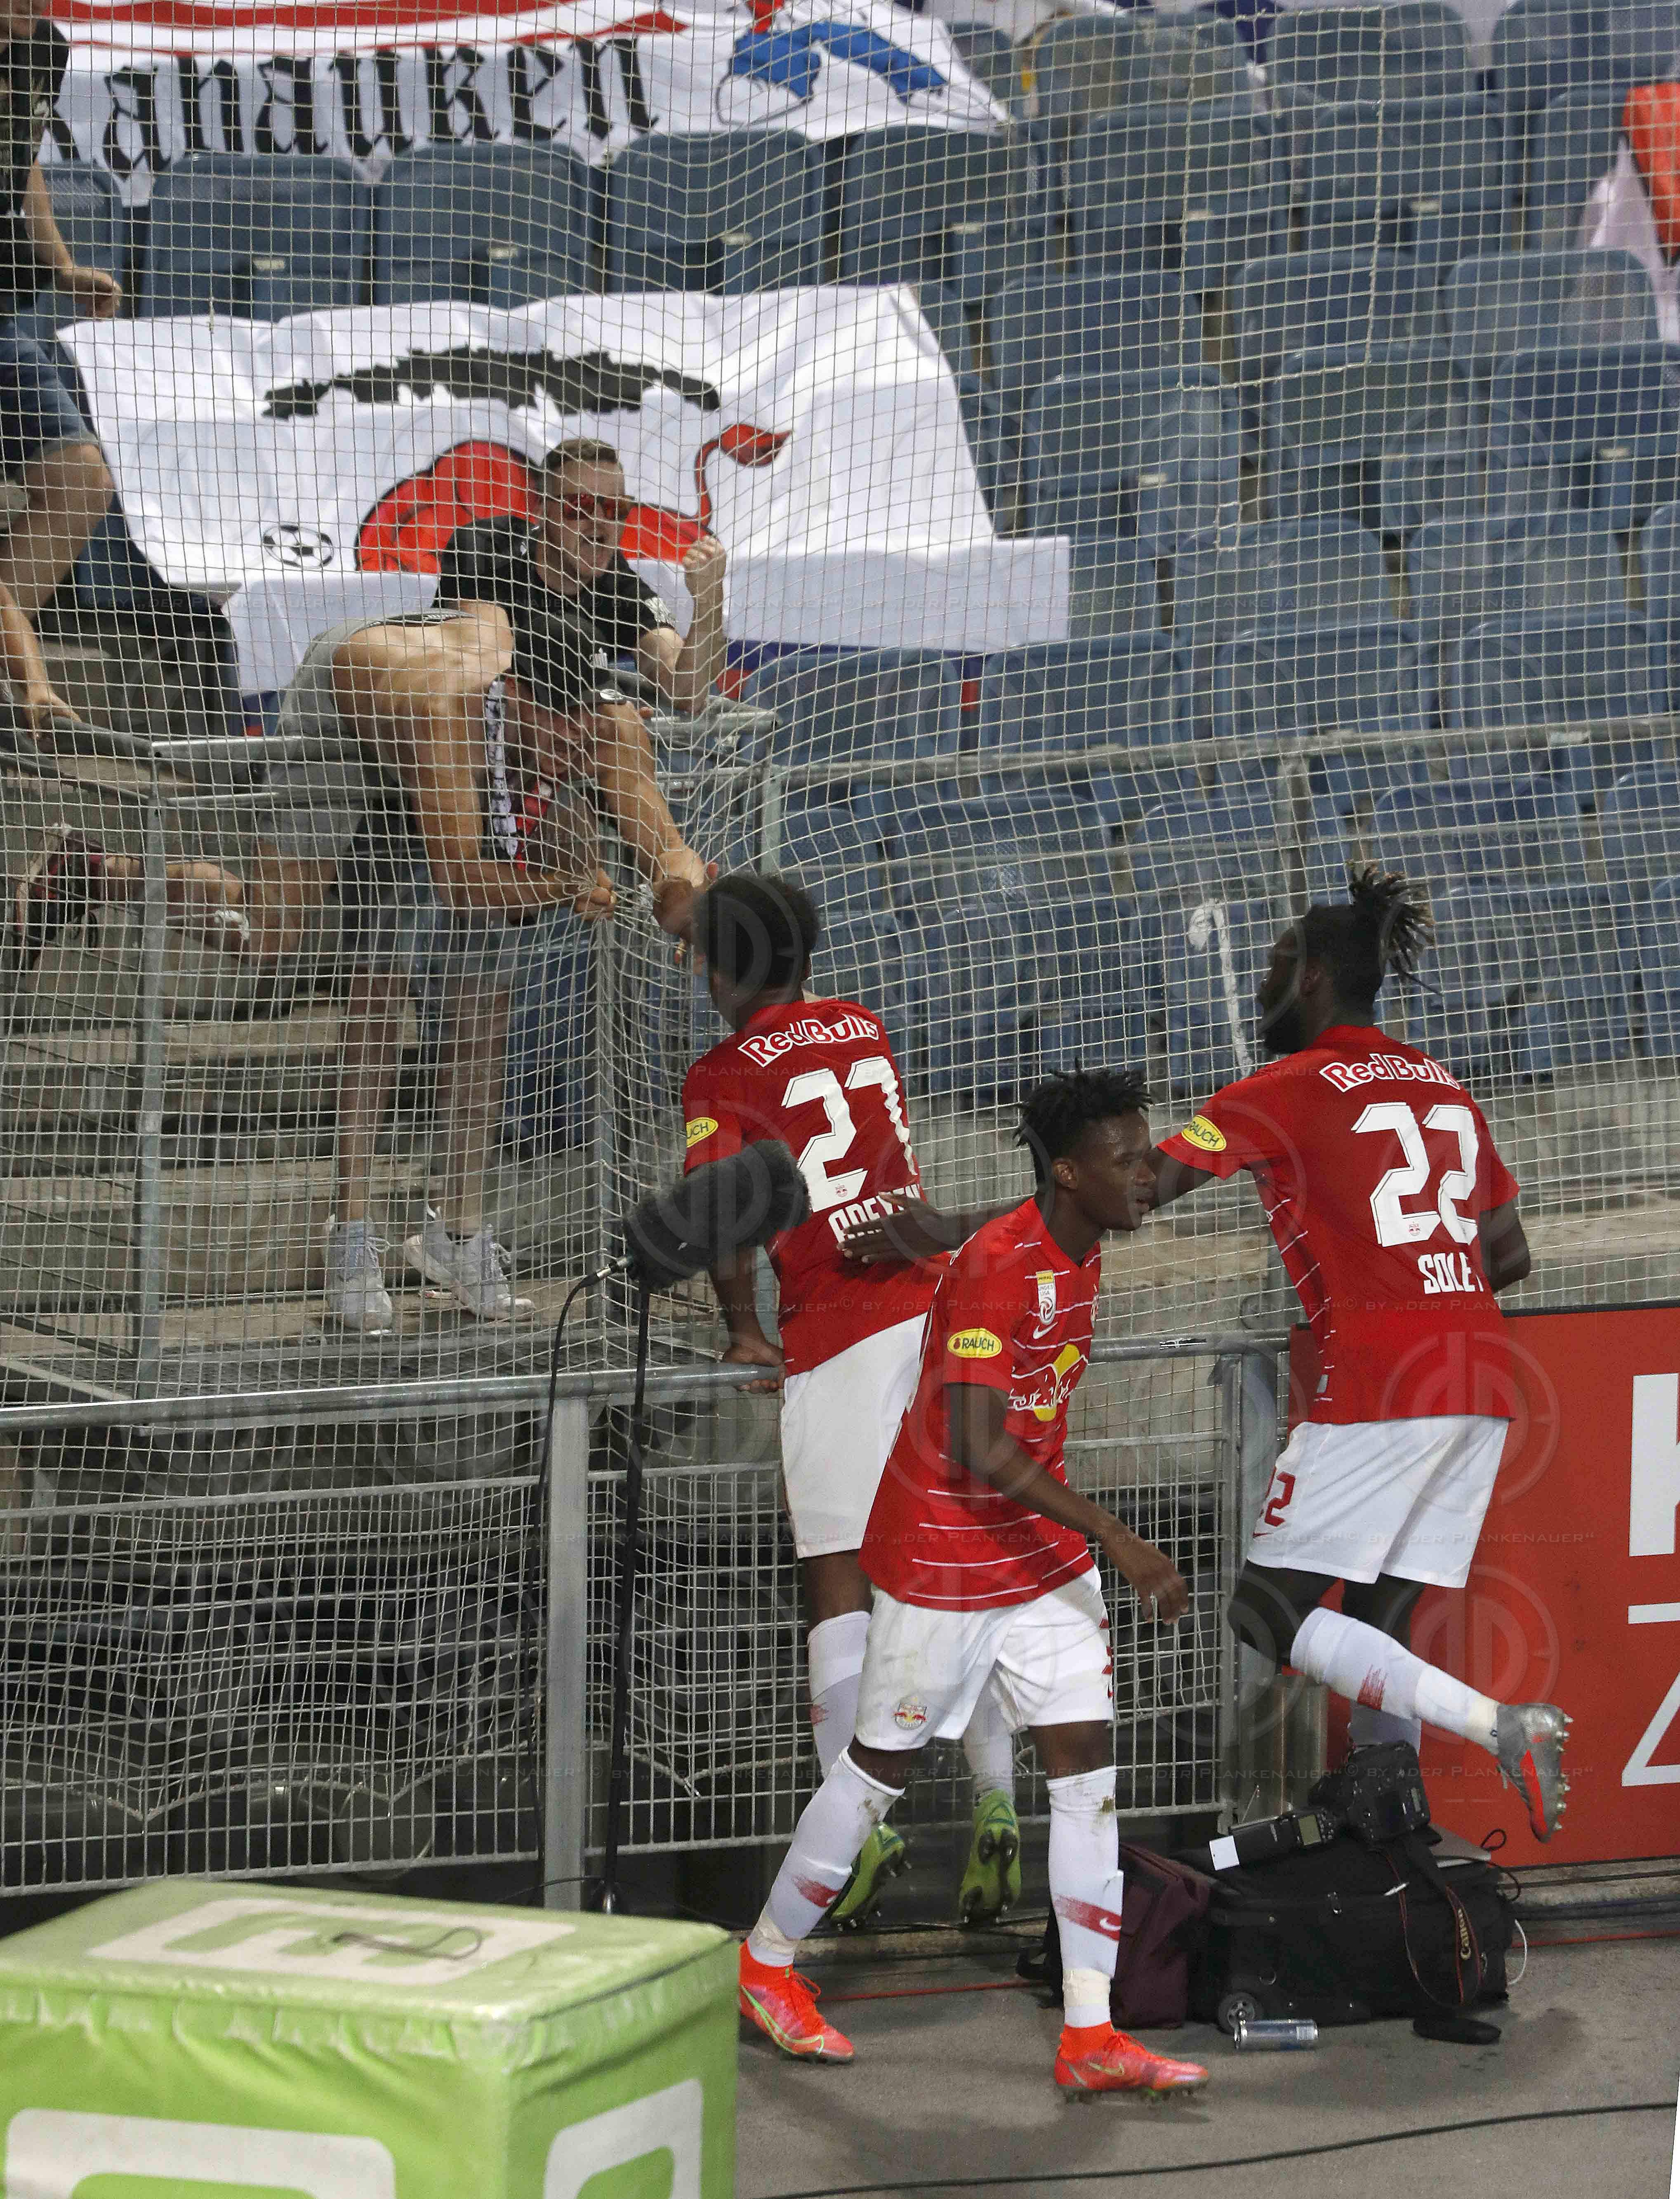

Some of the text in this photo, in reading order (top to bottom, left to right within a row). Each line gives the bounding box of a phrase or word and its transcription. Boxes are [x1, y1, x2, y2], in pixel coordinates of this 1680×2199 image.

[781, 1055, 918, 1213] 27
[1351, 1102, 1478, 1247] 22
[962, 1338, 995, 1352] RAUCH
